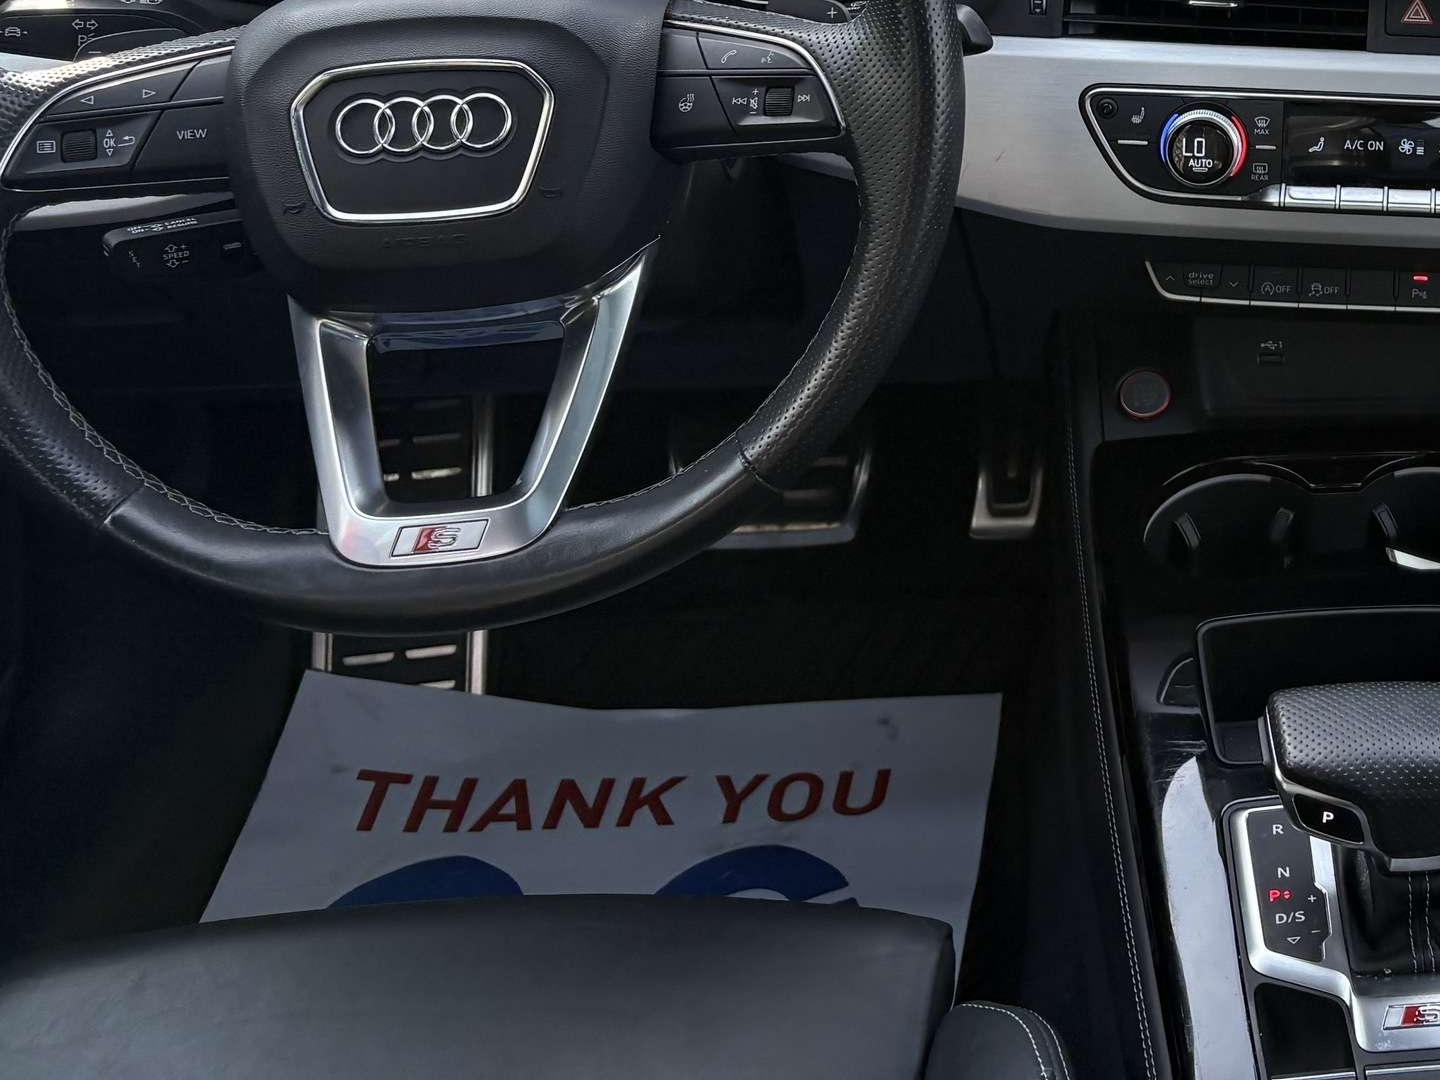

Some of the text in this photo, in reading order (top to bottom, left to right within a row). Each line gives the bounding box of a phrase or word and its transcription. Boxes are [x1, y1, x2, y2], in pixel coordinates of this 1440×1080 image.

[177, 128, 207, 140] VIEW
[103, 138, 116, 149] OK
[1182, 137, 1205, 157] LO
[1344, 139, 1384, 151] A/C ON
[1188, 159, 1213, 168] AUTO
[163, 250, 190, 260] SPEED
[1188, 271, 1214, 279] drive
[1188, 278, 1213, 286] select
[1275, 285, 1291, 293] OFF
[1323, 286, 1340, 294] OFF
[356, 768, 891, 833] THANK YOU
[1322, 811, 1334, 823] P
[1272, 824, 1284, 835] R
[1277, 867, 1290, 878] N
[1269, 890, 1281, 902] P
[1275, 910, 1306, 924] D/S
